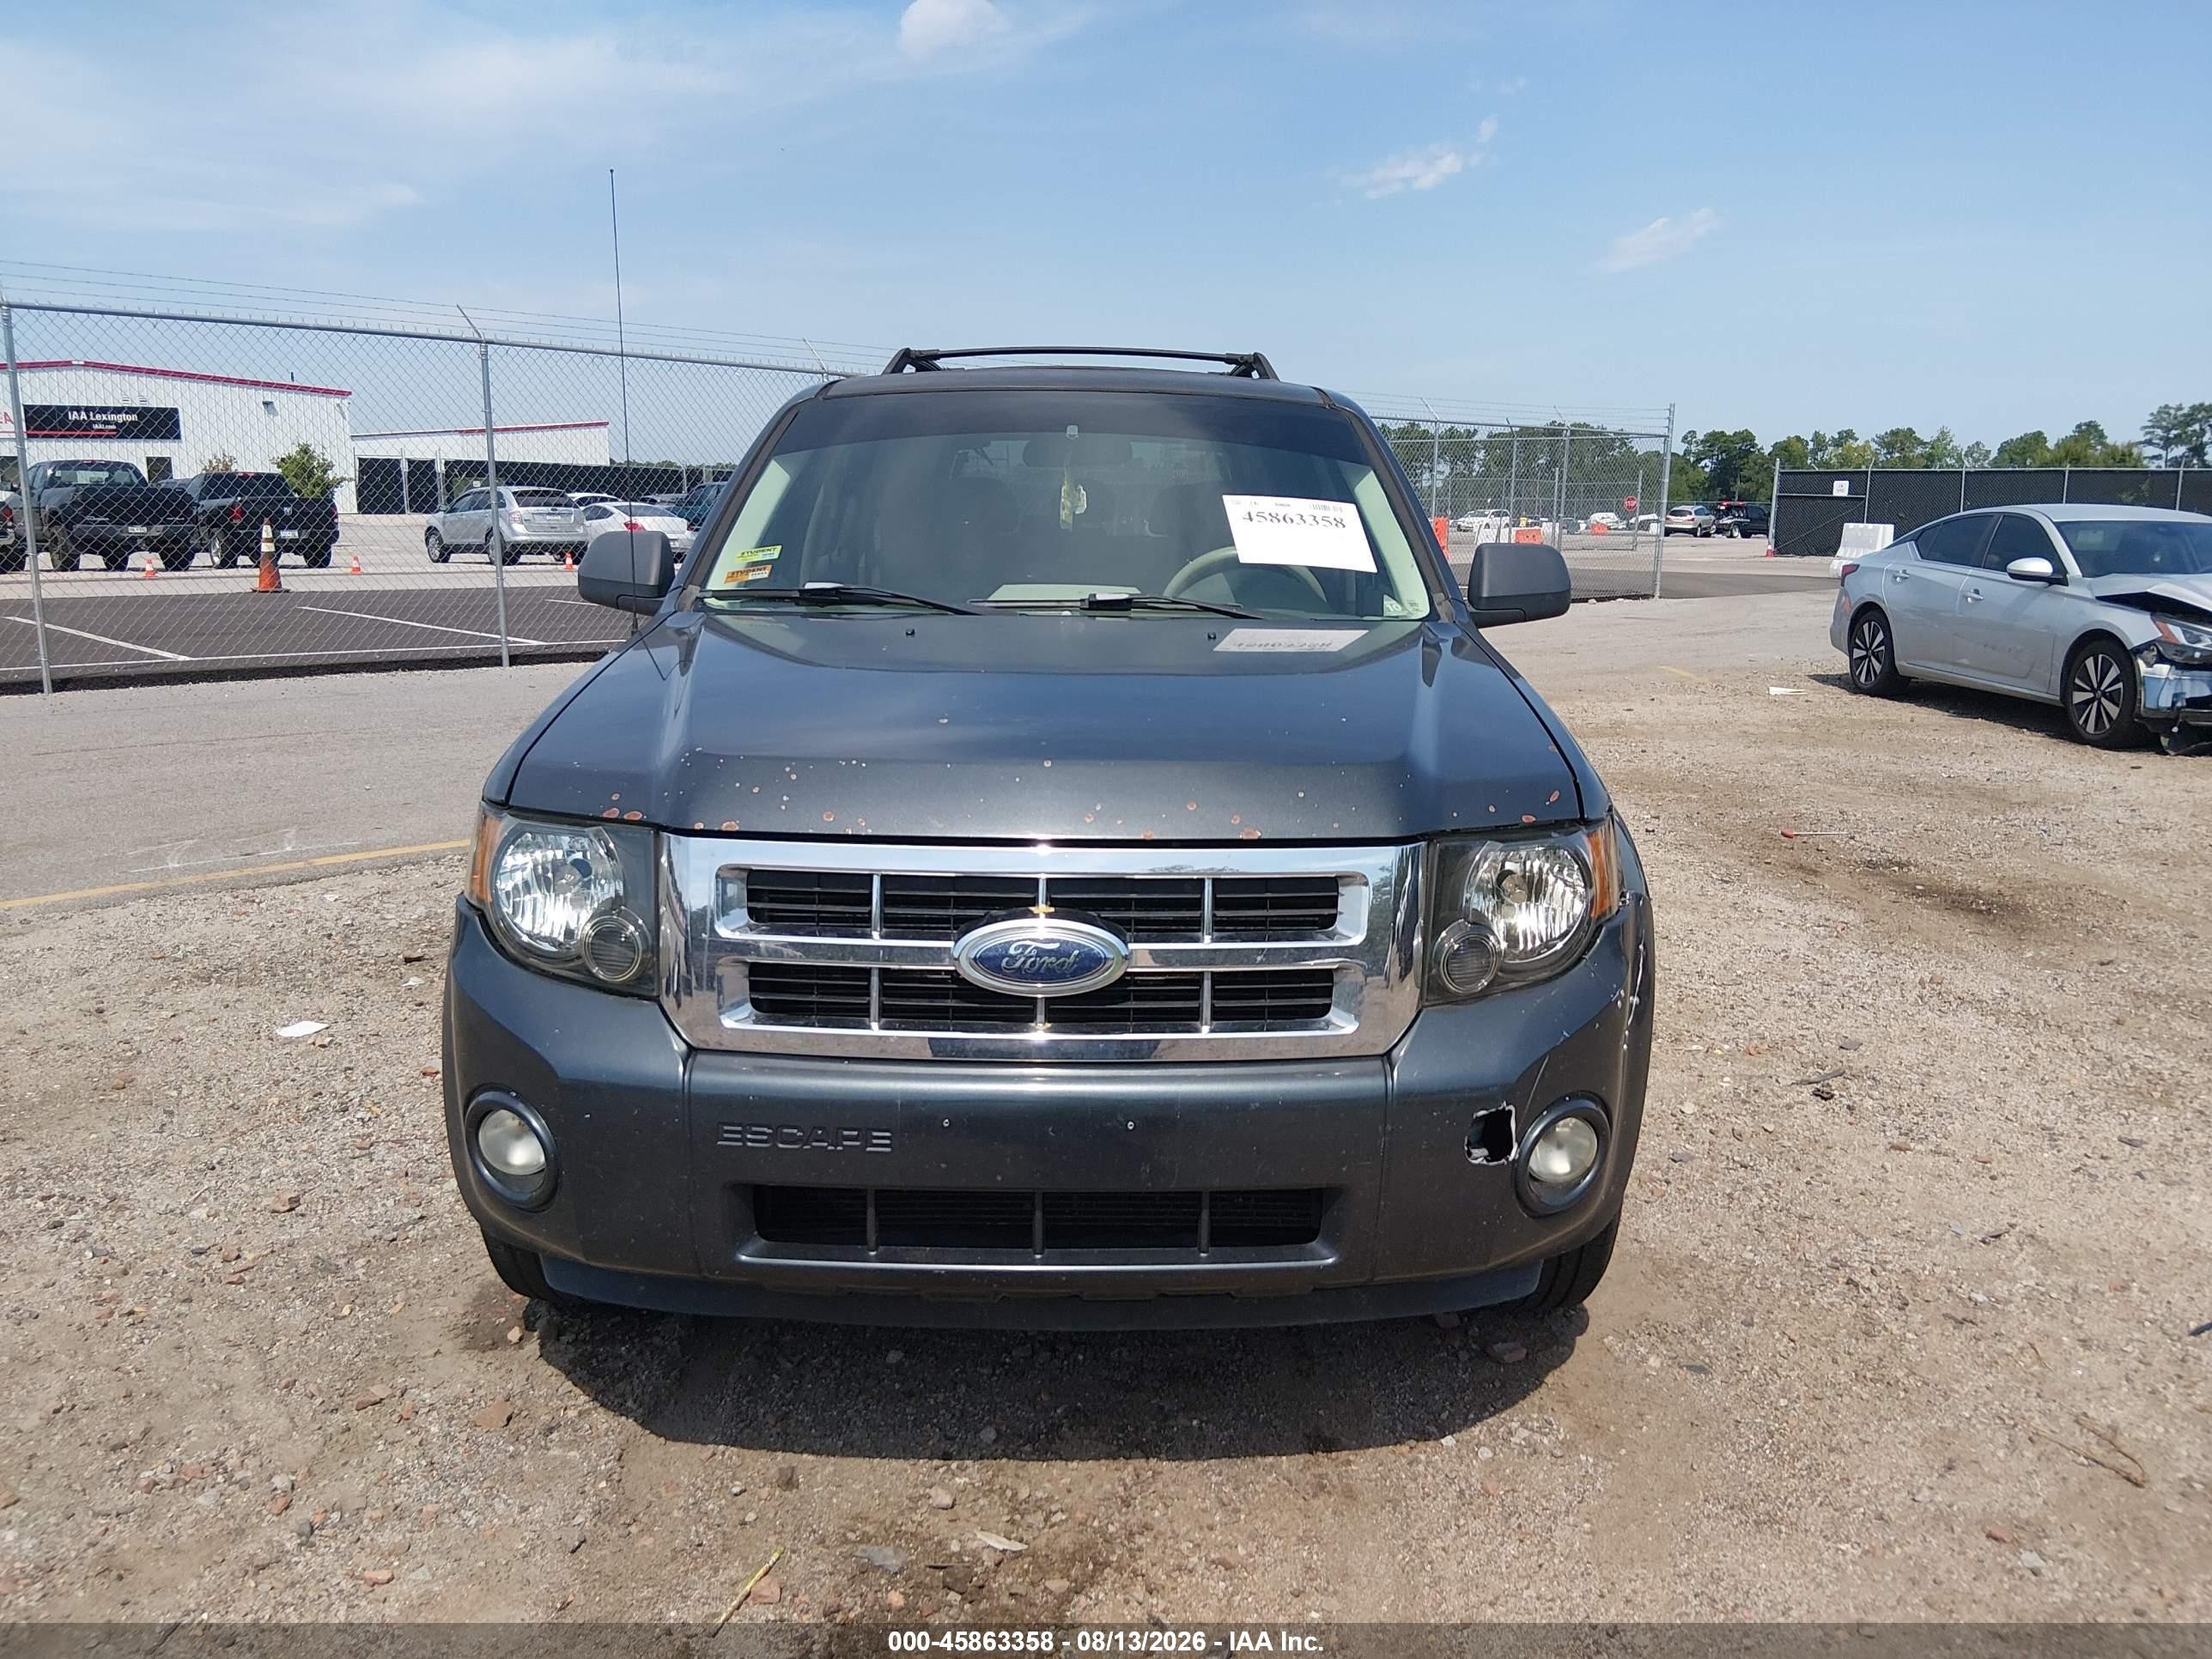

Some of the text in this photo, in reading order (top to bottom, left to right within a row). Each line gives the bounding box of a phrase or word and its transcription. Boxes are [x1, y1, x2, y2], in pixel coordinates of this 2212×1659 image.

[69, 410, 137, 422] IAA Lexington
[1243, 511, 1346, 528] 45863358
[739, 547, 778, 557] STUDENT
[730, 566, 767, 577] STUDENT
[1001, 940, 1080, 975] Ford
[717, 1122, 893, 1152] ESCAPE
